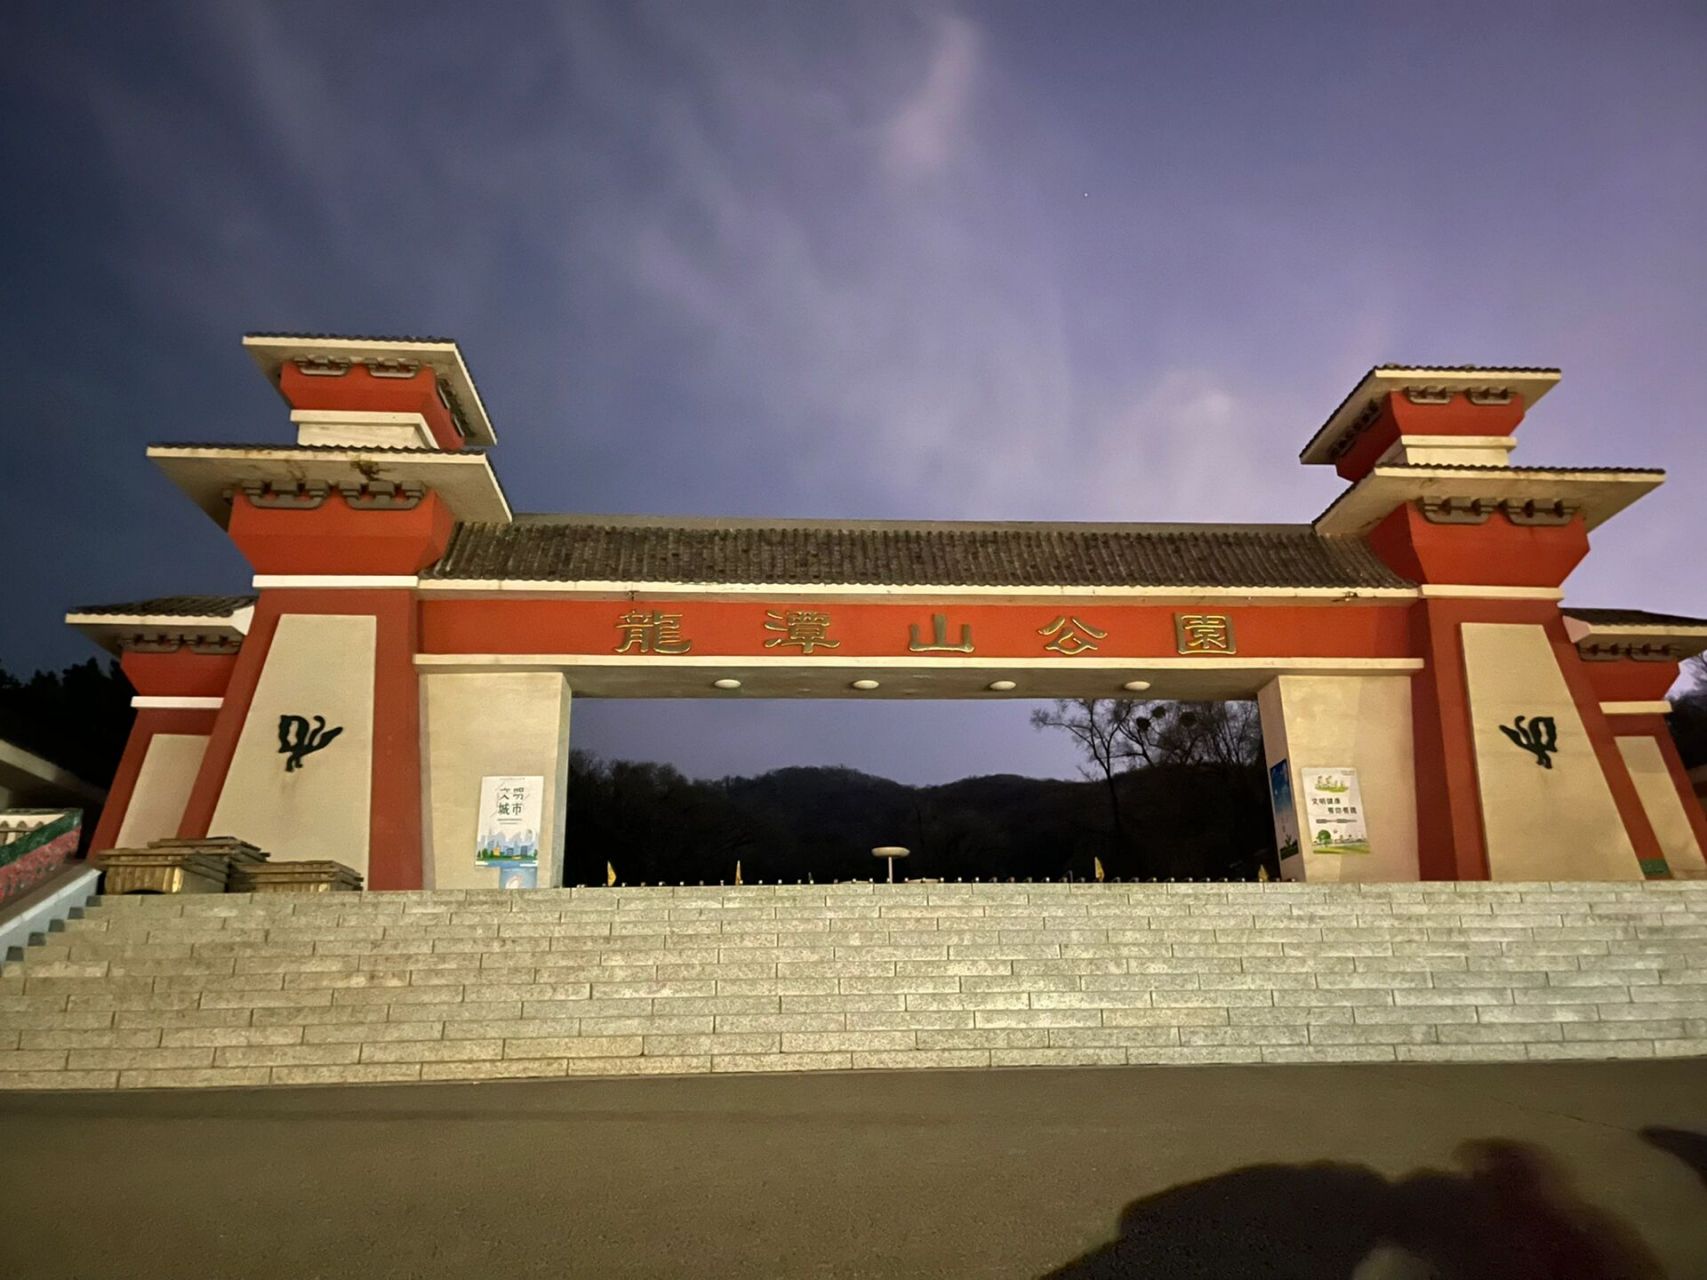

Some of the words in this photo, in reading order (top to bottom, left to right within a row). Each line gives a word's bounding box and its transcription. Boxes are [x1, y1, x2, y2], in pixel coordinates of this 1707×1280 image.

[614, 609, 1237, 655] 龍潭山公園
[498, 803, 523, 816] 城市
